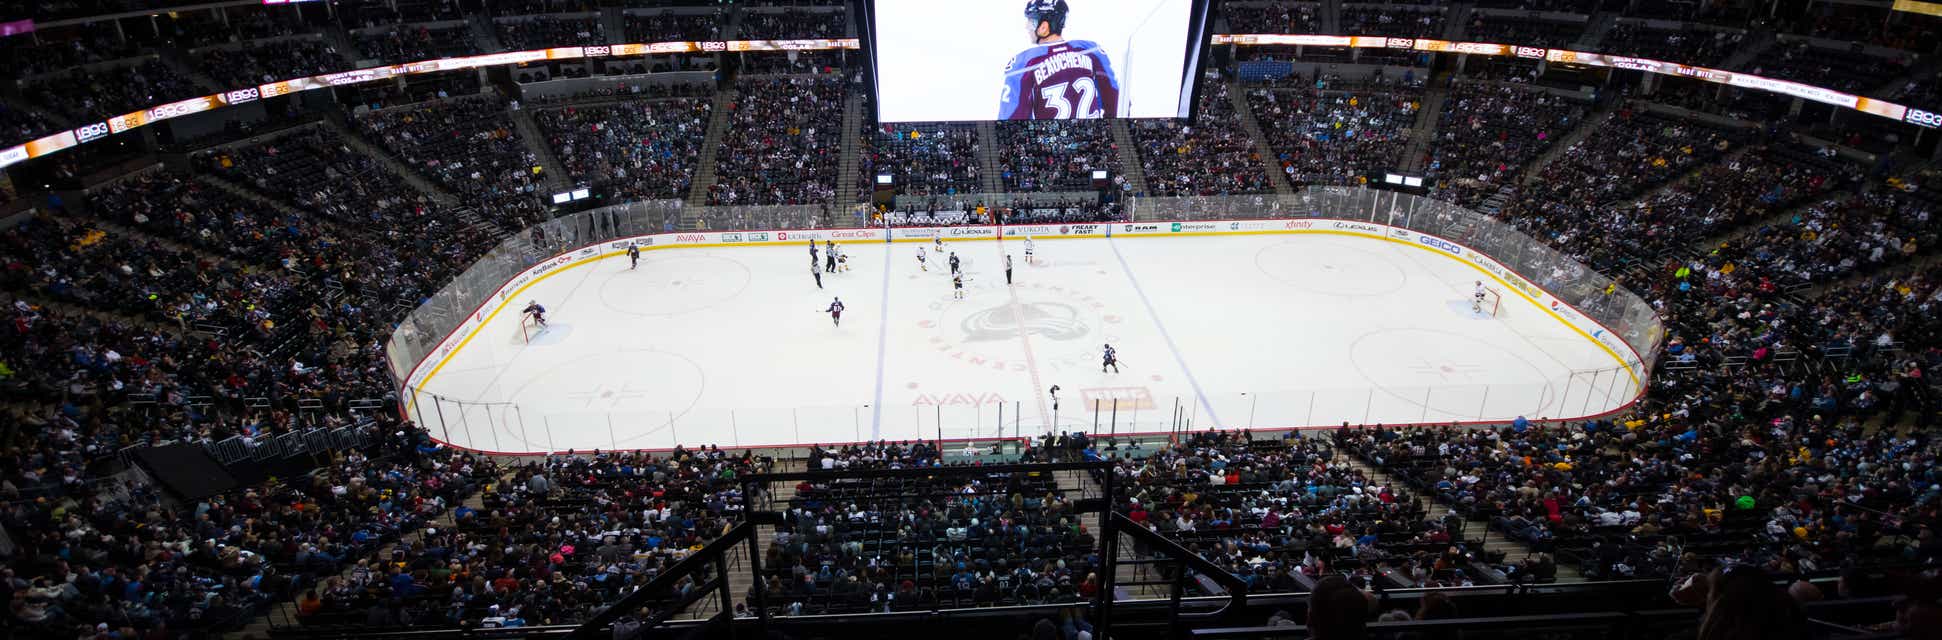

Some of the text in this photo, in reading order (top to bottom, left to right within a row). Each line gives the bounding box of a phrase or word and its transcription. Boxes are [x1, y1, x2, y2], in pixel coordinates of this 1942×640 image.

[227, 87, 259, 102] 1893
[1041, 76, 1103, 119] 32
[149, 104, 188, 121] 1893
[1906, 108, 1942, 126] 1893
[75, 122, 109, 141] 1893
[1285, 220, 1313, 230] xfinity
[676, 234, 707, 243] AVAYA
[856, 230, 875, 239] Clips
[1420, 235, 1461, 254] GEICO
[532, 261, 558, 275] KeyBank
[912, 392, 1008, 407] AVAYA
